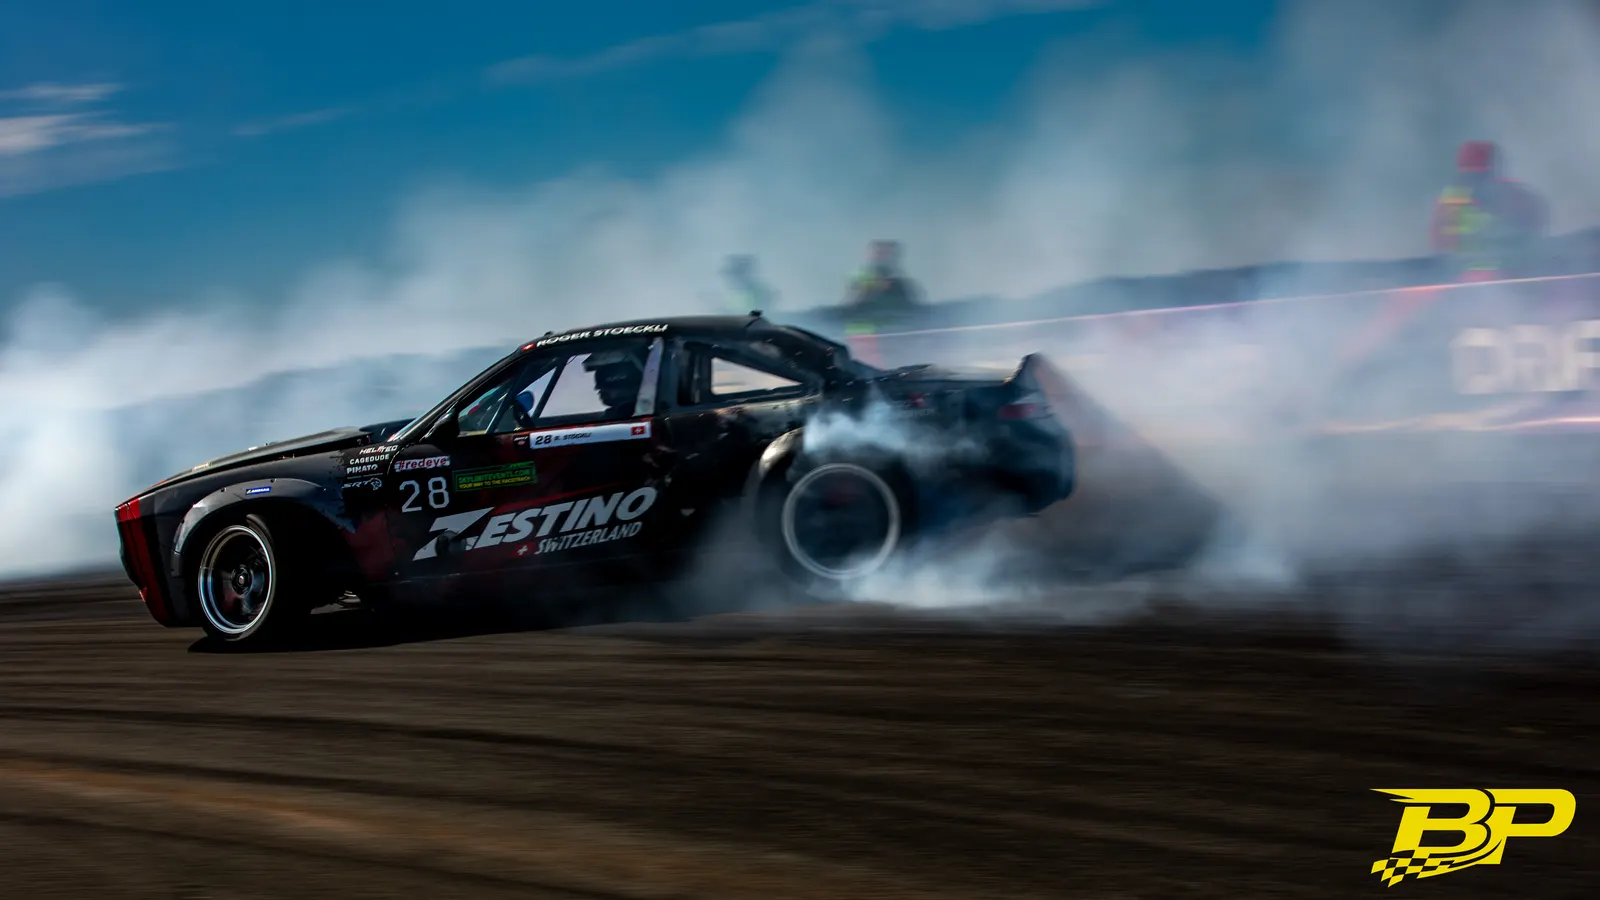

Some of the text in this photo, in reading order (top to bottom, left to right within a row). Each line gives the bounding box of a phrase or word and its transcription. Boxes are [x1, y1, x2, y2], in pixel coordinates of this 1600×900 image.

[536, 331, 591, 347] ROGER
[535, 435, 552, 446] 28
[397, 457, 447, 471] #redeye
[399, 476, 450, 513] 28
[411, 486, 659, 562] ZESTINO
[533, 520, 643, 555] SWITZERLAND
